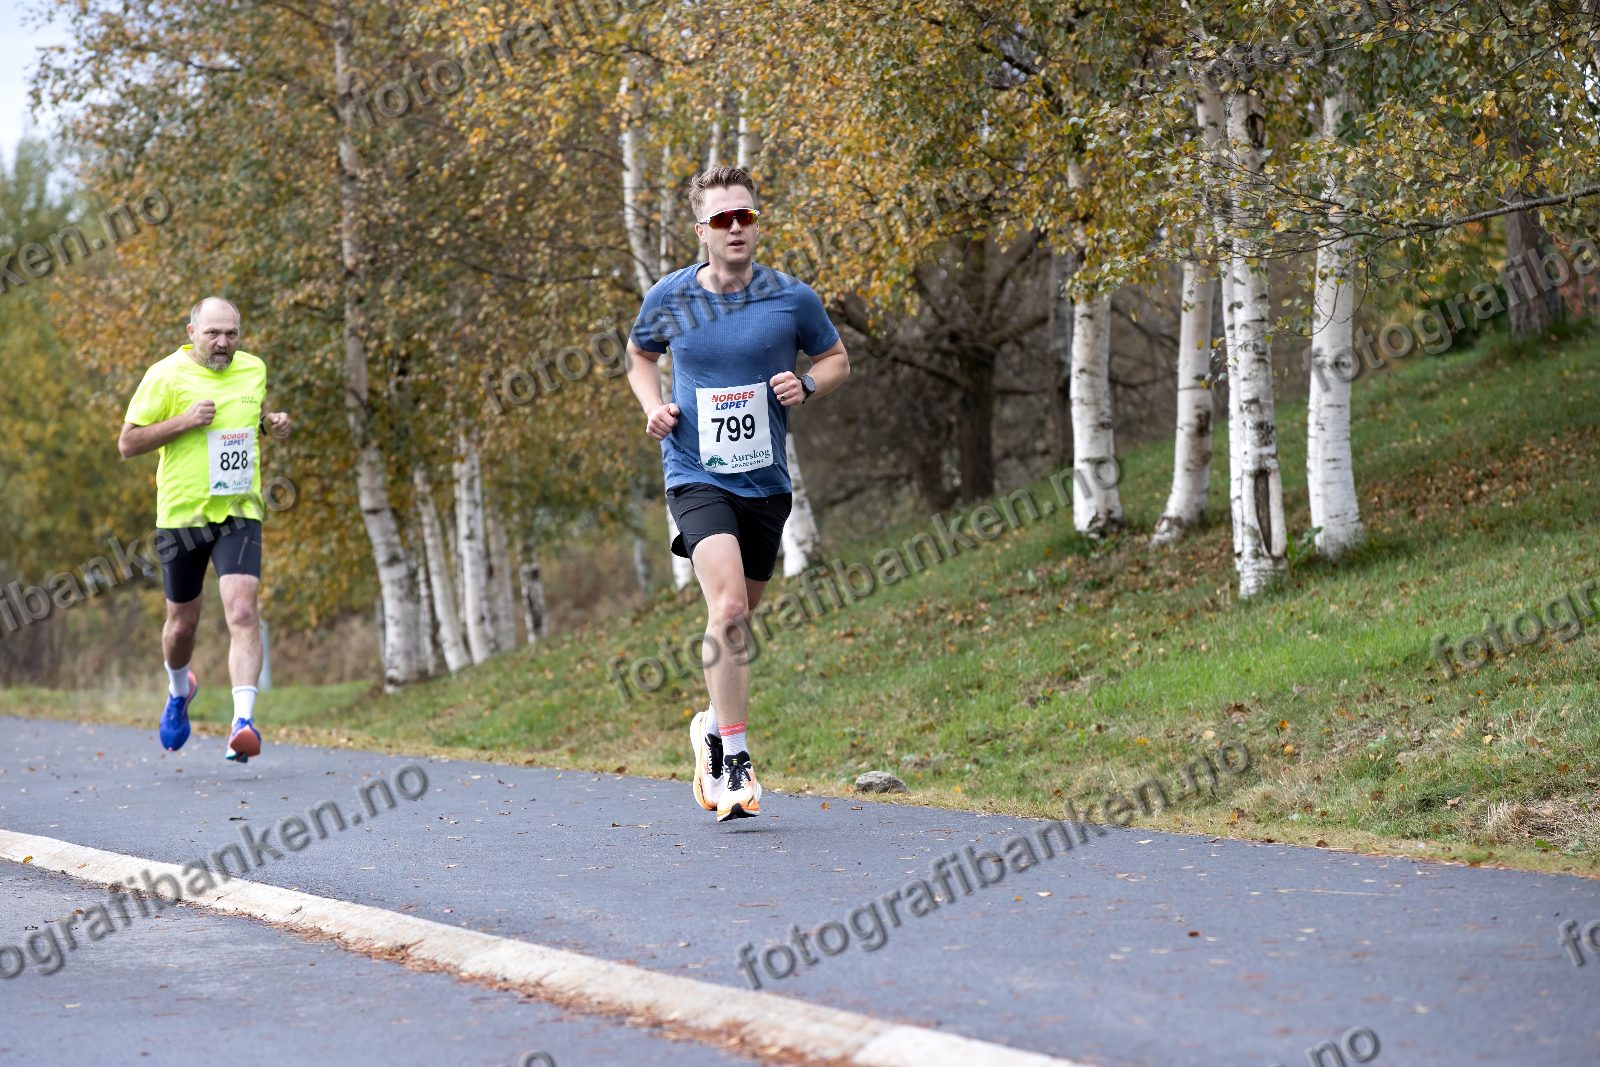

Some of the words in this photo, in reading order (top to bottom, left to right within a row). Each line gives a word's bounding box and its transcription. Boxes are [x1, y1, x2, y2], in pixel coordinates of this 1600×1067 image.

[711, 390, 755, 403] NORGES
[715, 400, 748, 411] LØPET
[711, 413, 756, 443] 799
[220, 432, 249, 441] NORGES
[223, 438, 245, 447] LØPET
[220, 450, 249, 471] 828
[731, 449, 771, 463] Aurskog
